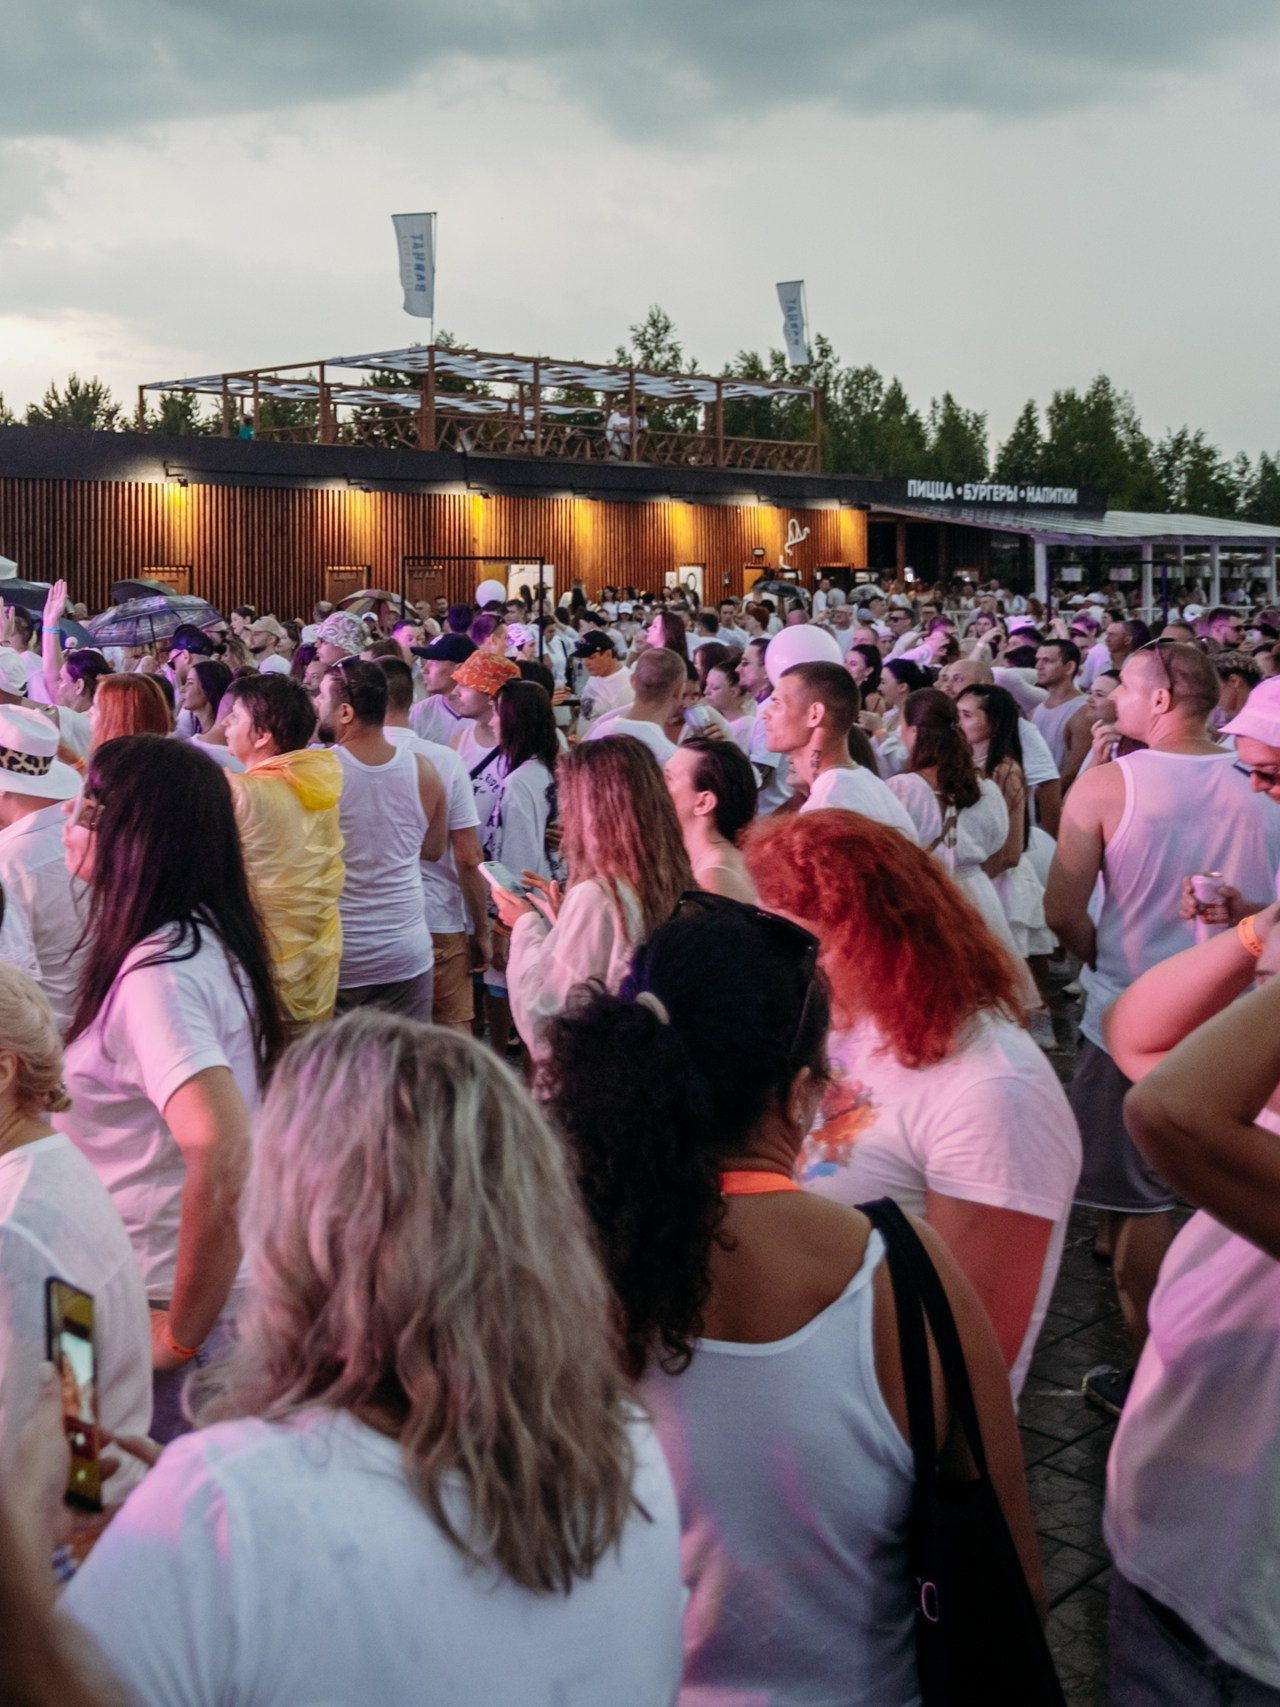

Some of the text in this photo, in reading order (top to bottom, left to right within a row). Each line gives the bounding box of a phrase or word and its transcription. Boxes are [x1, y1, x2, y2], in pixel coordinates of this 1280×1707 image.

[907, 480, 1078, 504] ПИЦЦА БУРГЕРЫ НАПИТКИ
